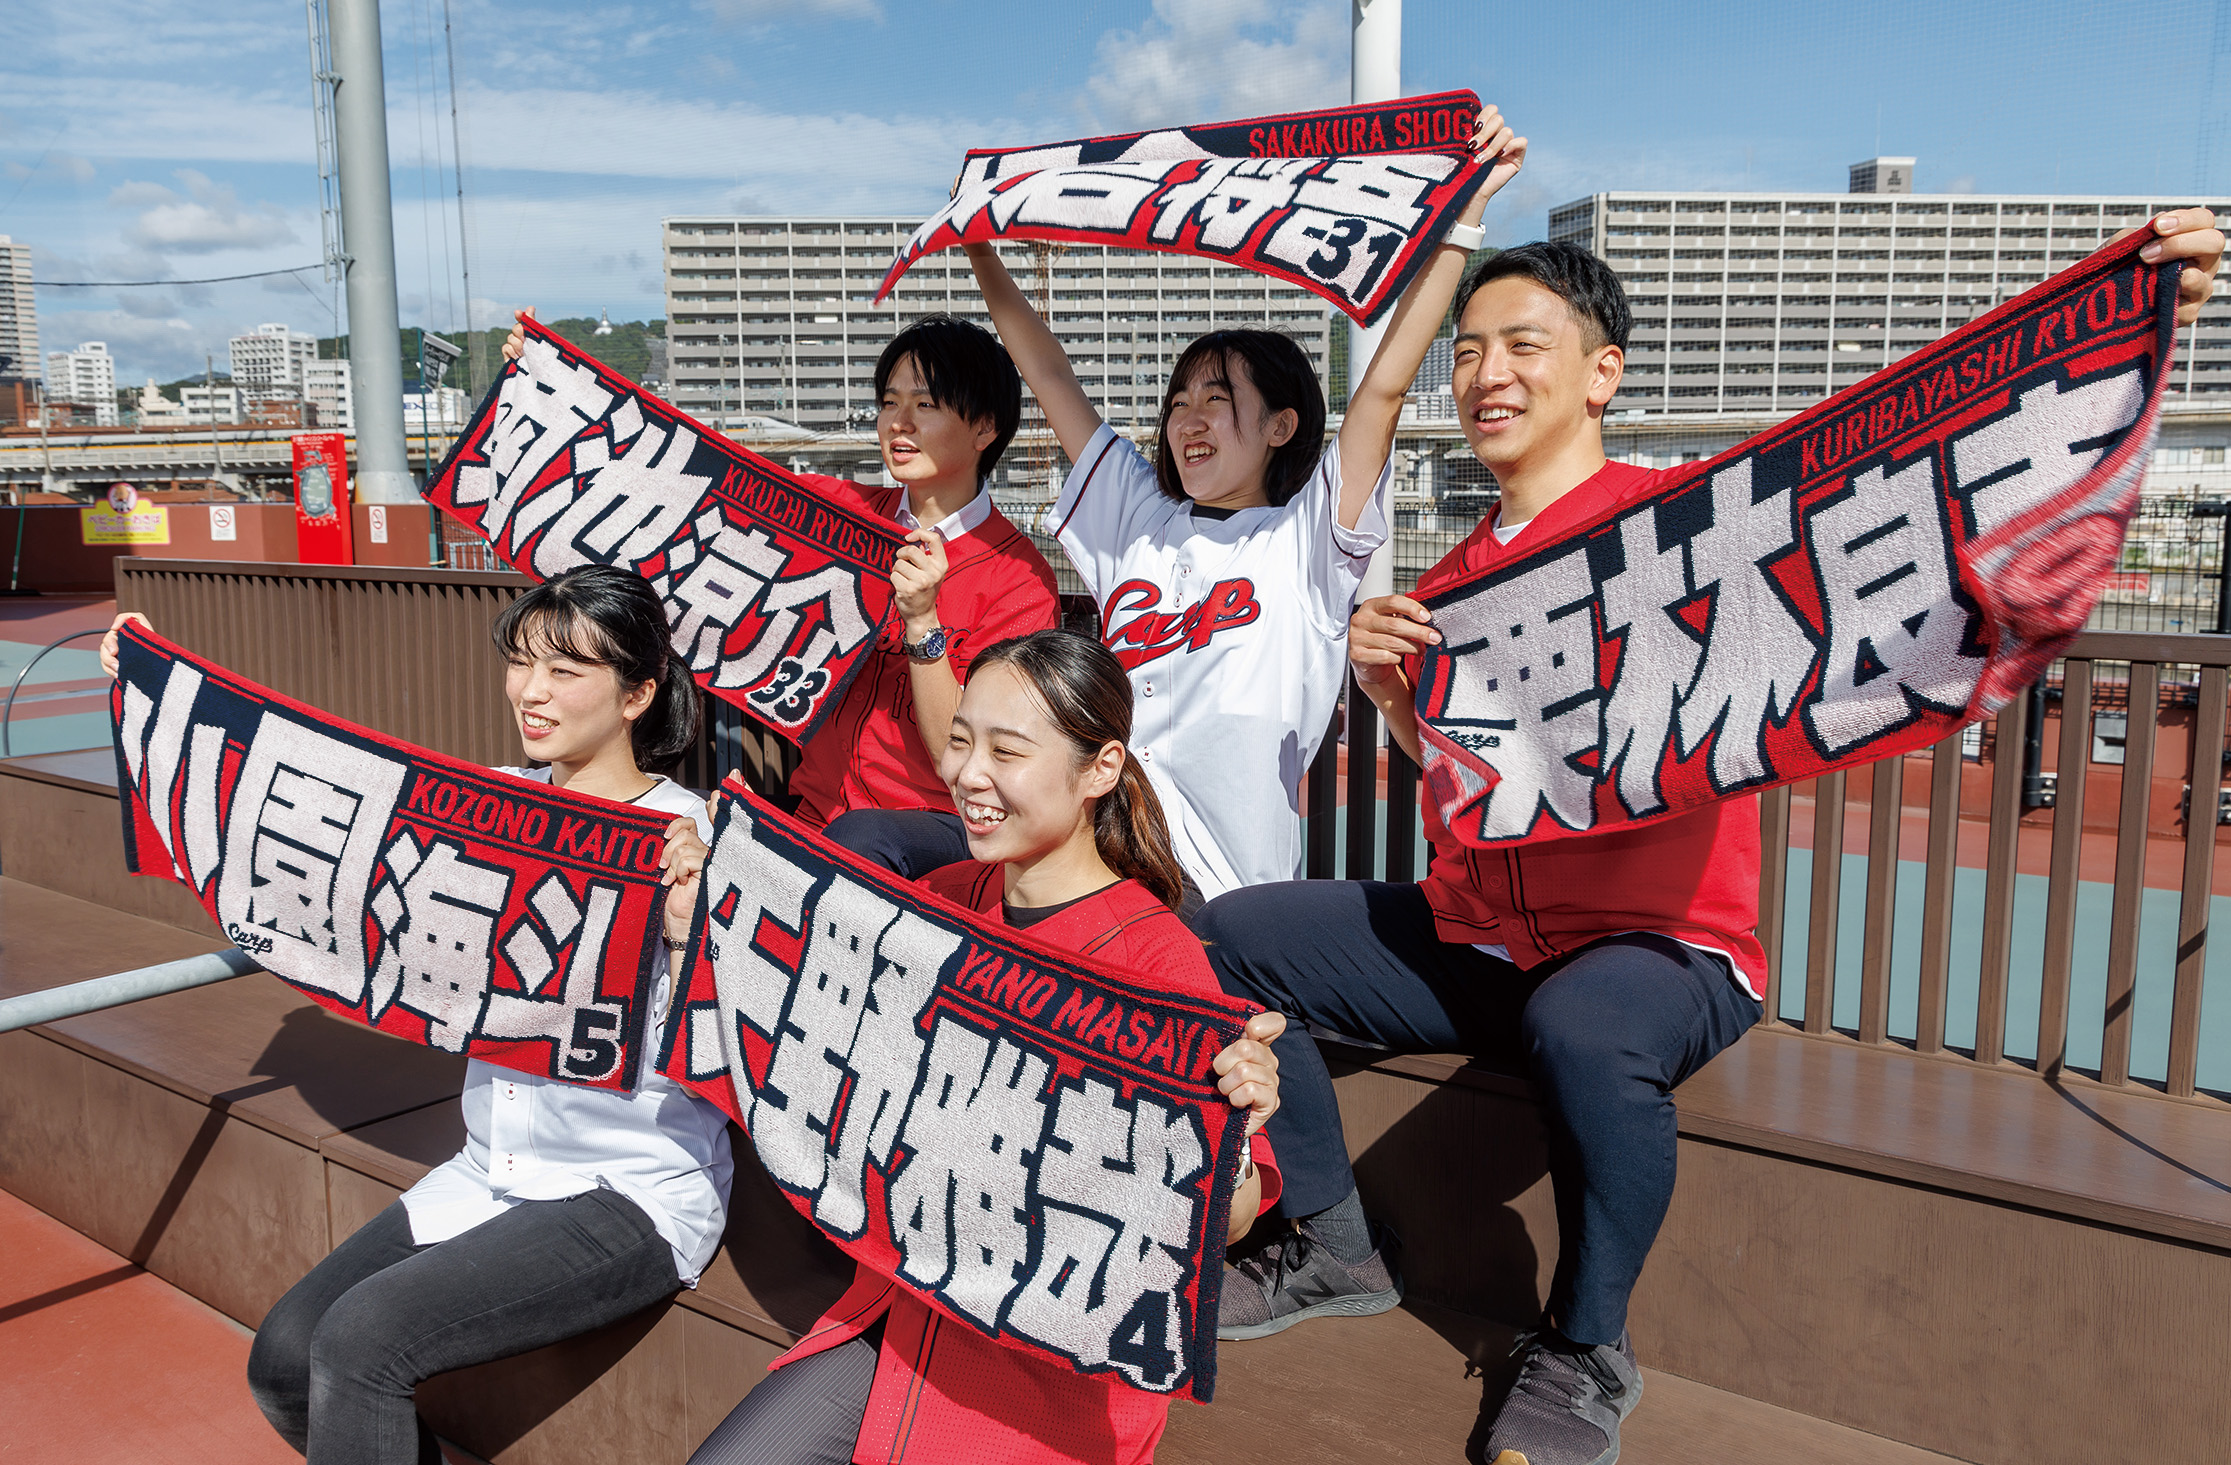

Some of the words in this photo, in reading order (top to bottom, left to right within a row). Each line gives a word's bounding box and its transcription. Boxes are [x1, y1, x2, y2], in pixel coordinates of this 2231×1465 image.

[1249, 115, 1387, 158] SAKAKURA
[1395, 108, 1478, 147] SHOG
[1301, 217, 1404, 301] 31
[1801, 329, 2023, 479] KURIBAYASHI
[720, 463, 808, 531] KIKUCHI
[1101, 577, 1261, 673] Carp
[750, 660, 827, 723] 33
[407, 773, 549, 846] KOZONO
[554, 816, 664, 873] KAITO
[228, 922, 273, 954] Carp
[955, 943, 1058, 1020] YANO
[564, 1008, 618, 1077] 5
[1108, 1289, 1177, 1385] 4
